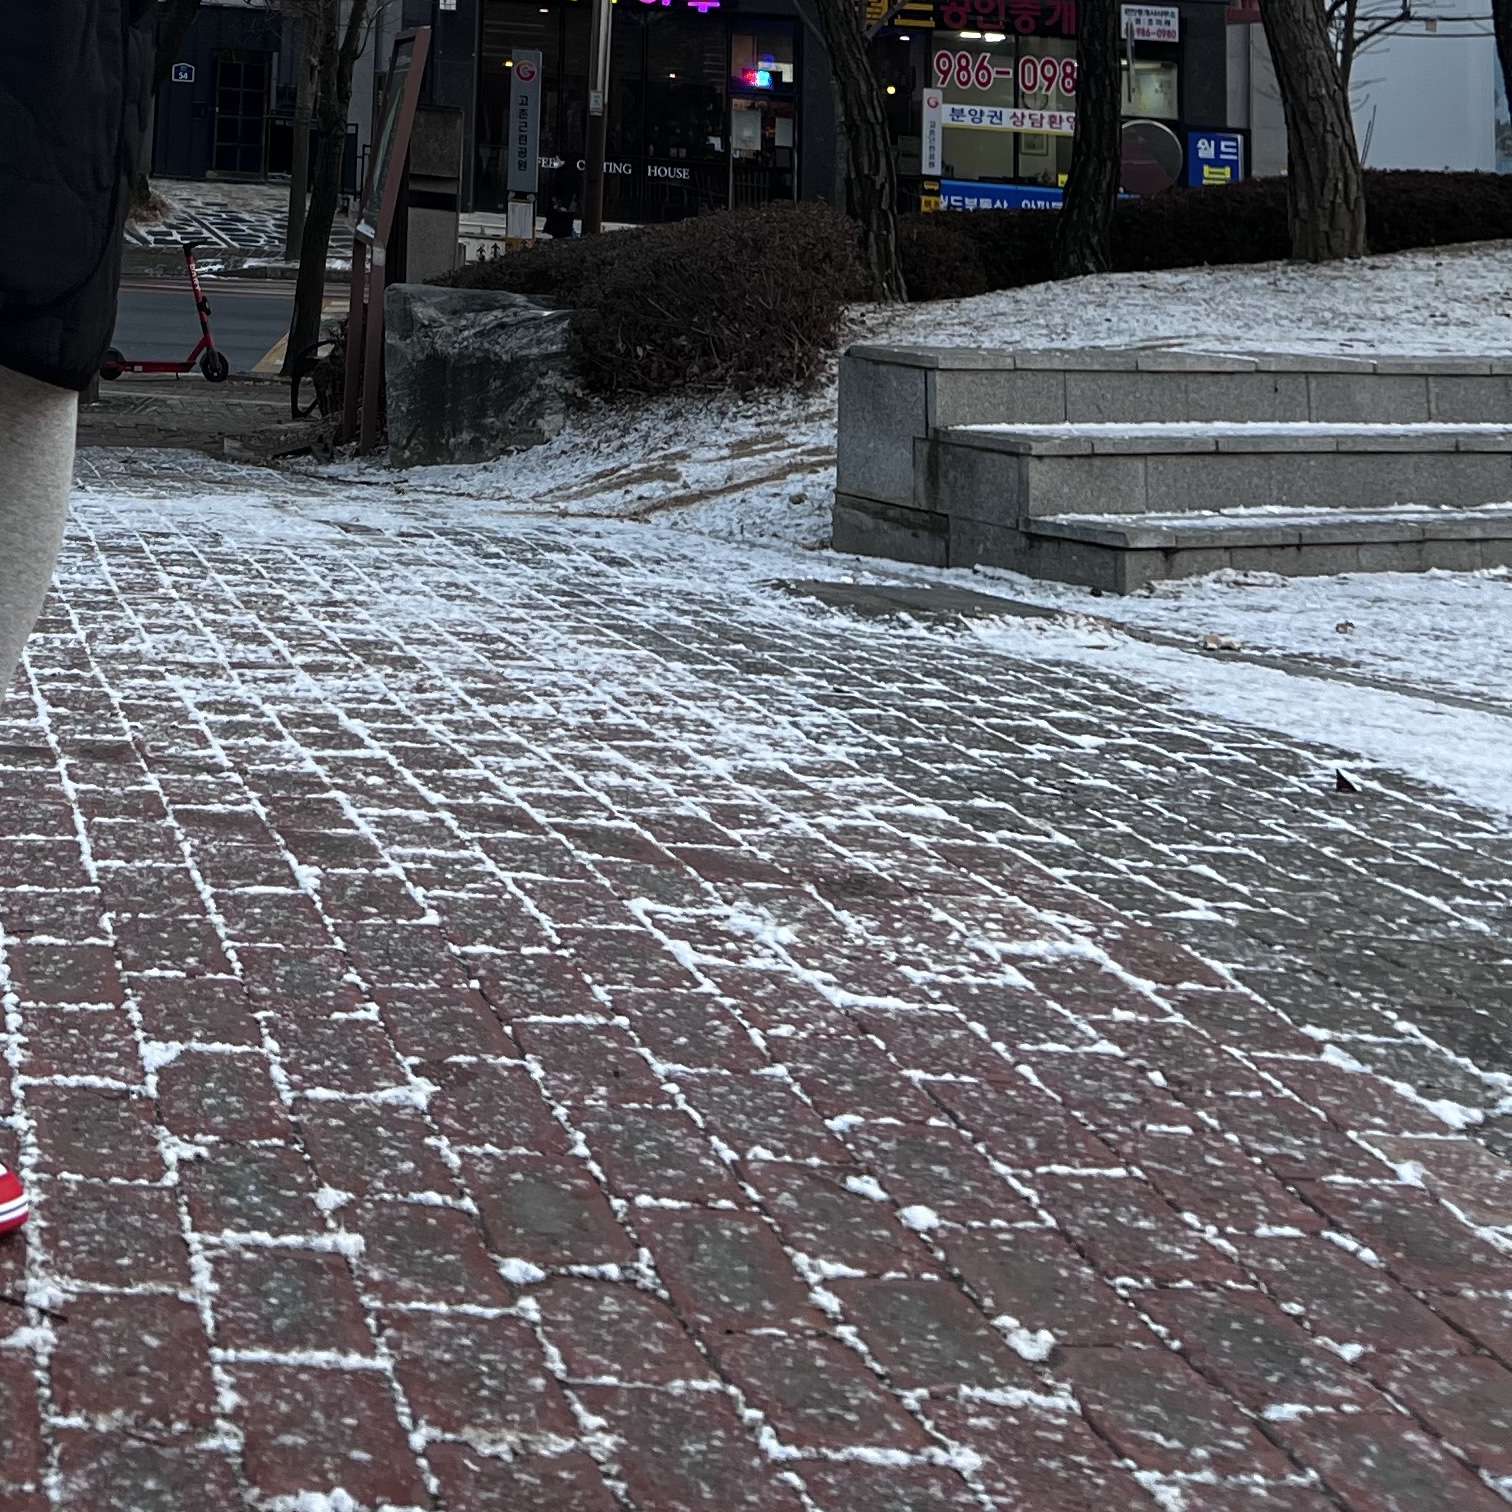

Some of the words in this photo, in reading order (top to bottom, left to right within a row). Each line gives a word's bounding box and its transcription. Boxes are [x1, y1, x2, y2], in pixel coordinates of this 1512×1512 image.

[949, 107, 1003, 125] 분양권
[1197, 138, 1238, 160] 월드
[647, 165, 691, 180] HOUSE
